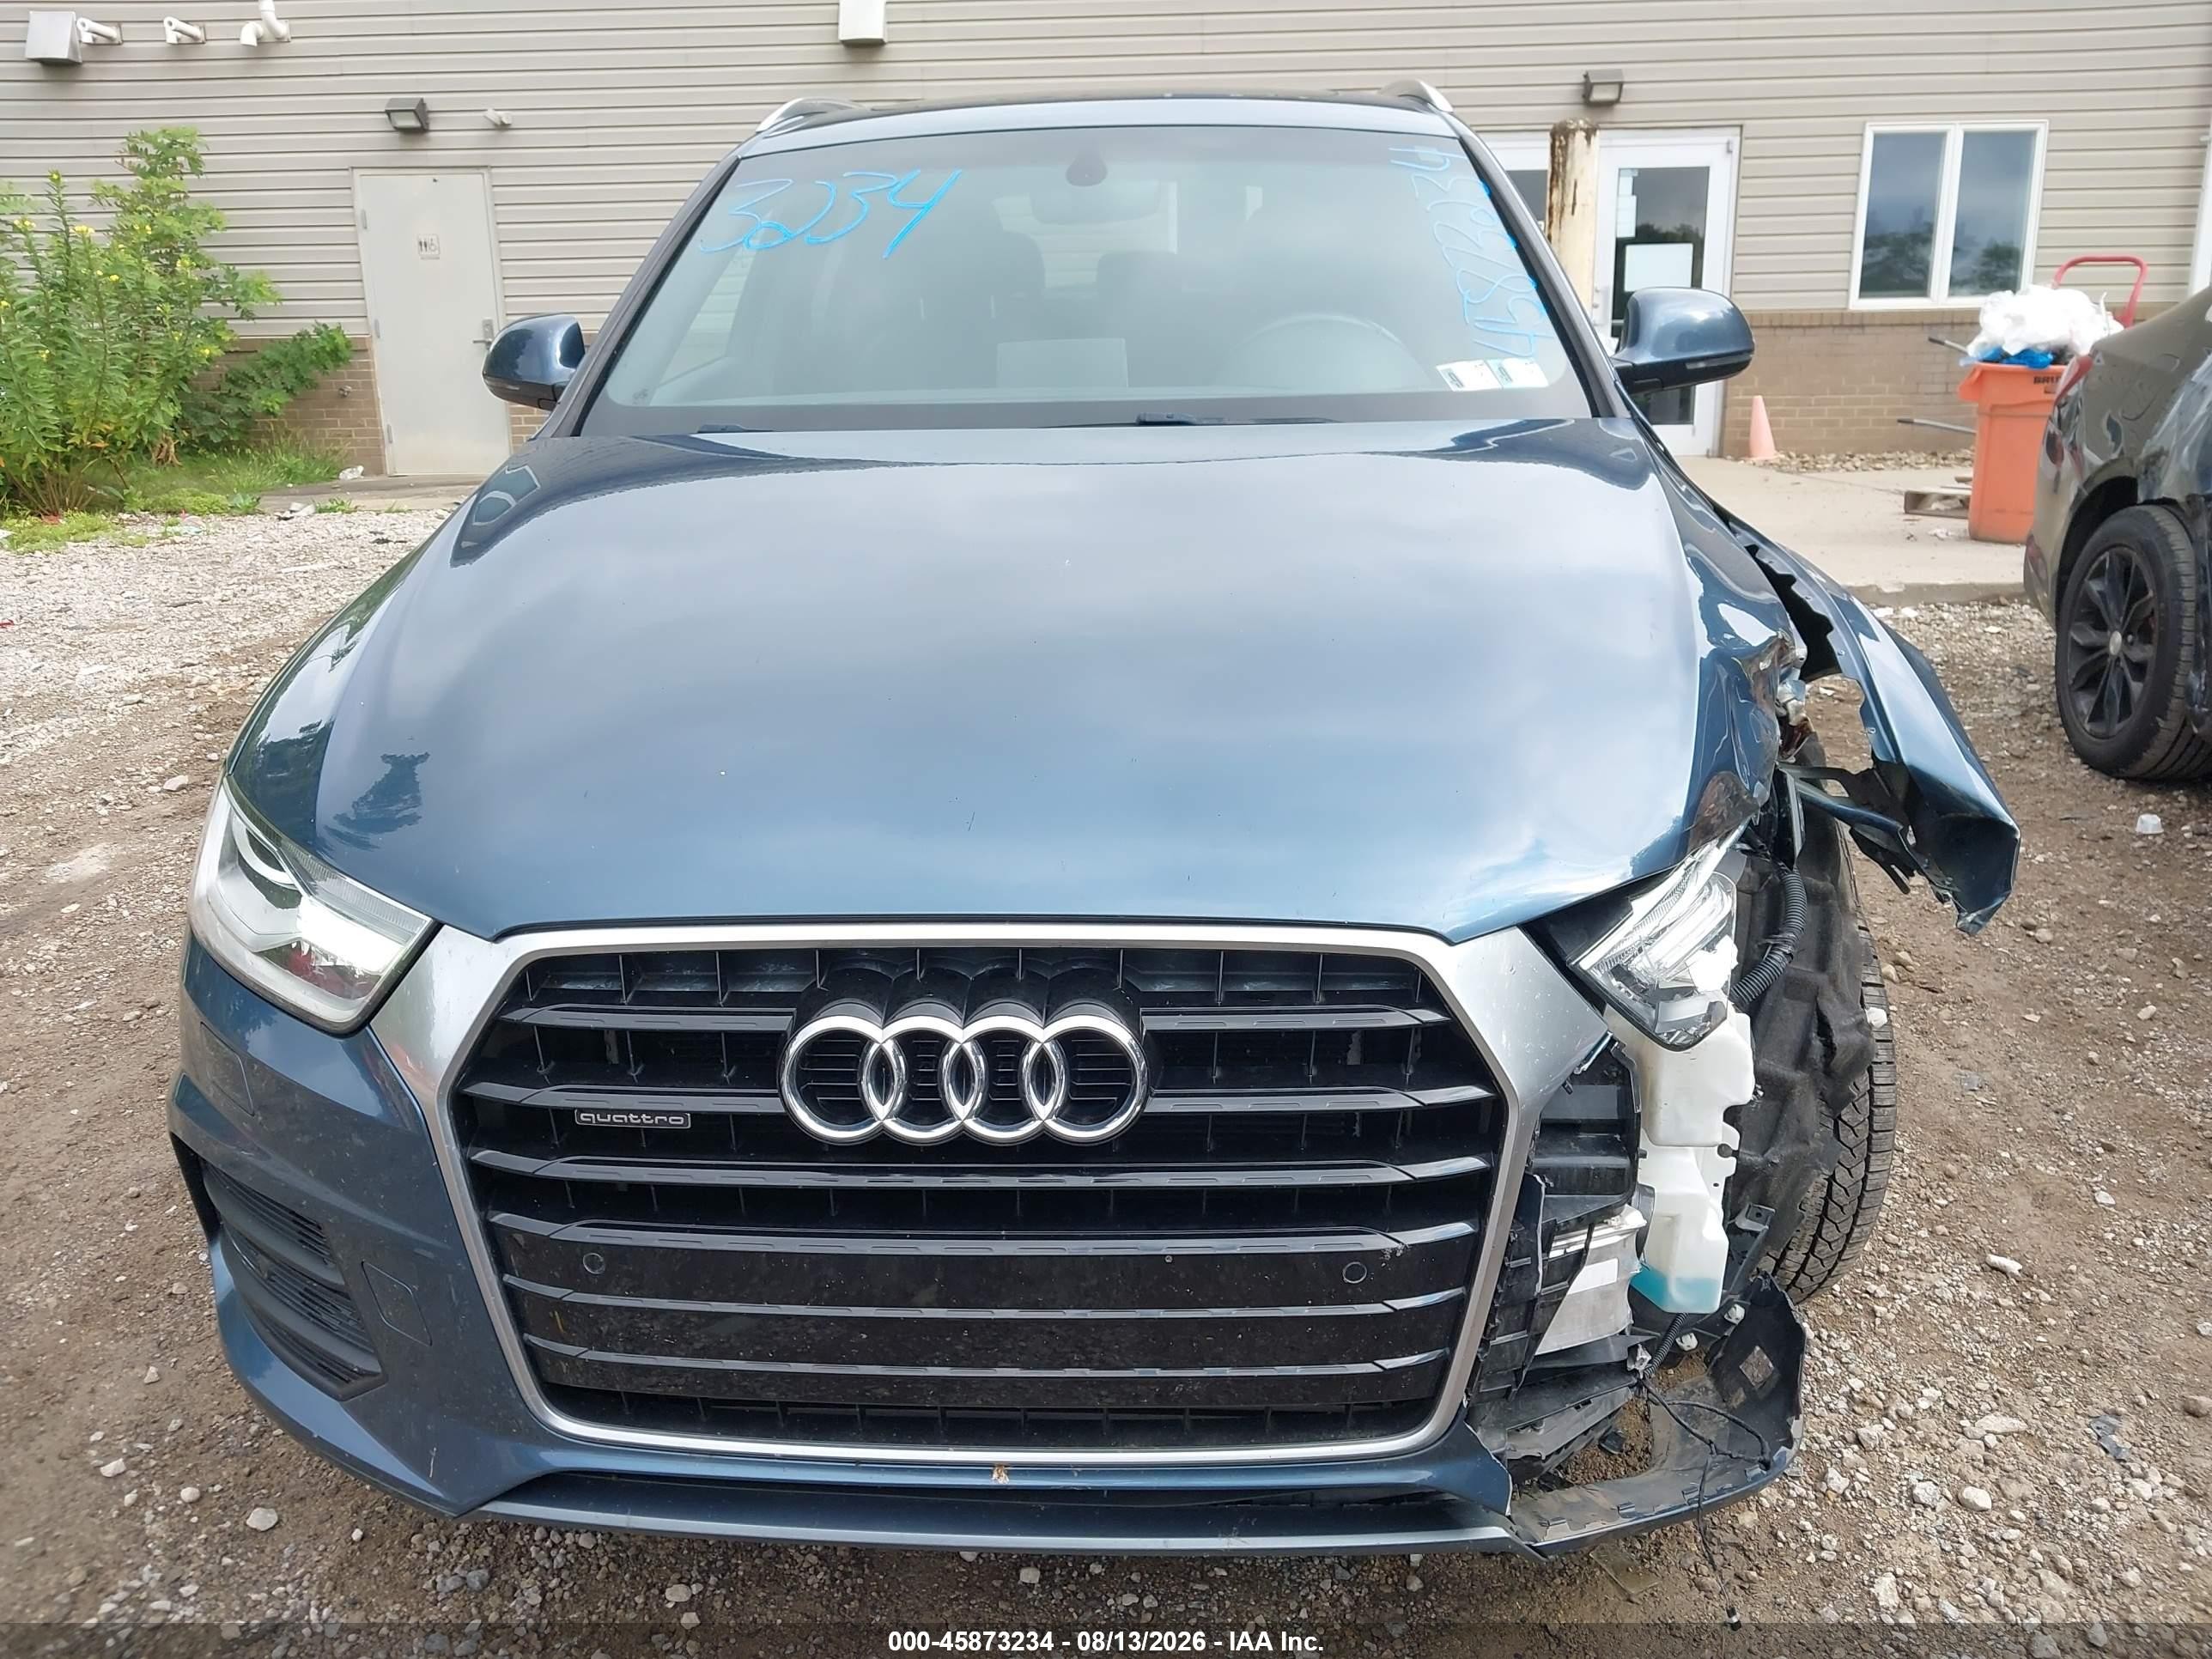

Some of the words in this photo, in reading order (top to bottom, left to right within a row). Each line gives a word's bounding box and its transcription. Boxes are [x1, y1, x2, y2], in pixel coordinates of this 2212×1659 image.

[699, 168, 963, 259] 3234
[1388, 146, 1554, 357] 45873234
[580, 1112, 685, 1125] quattro
